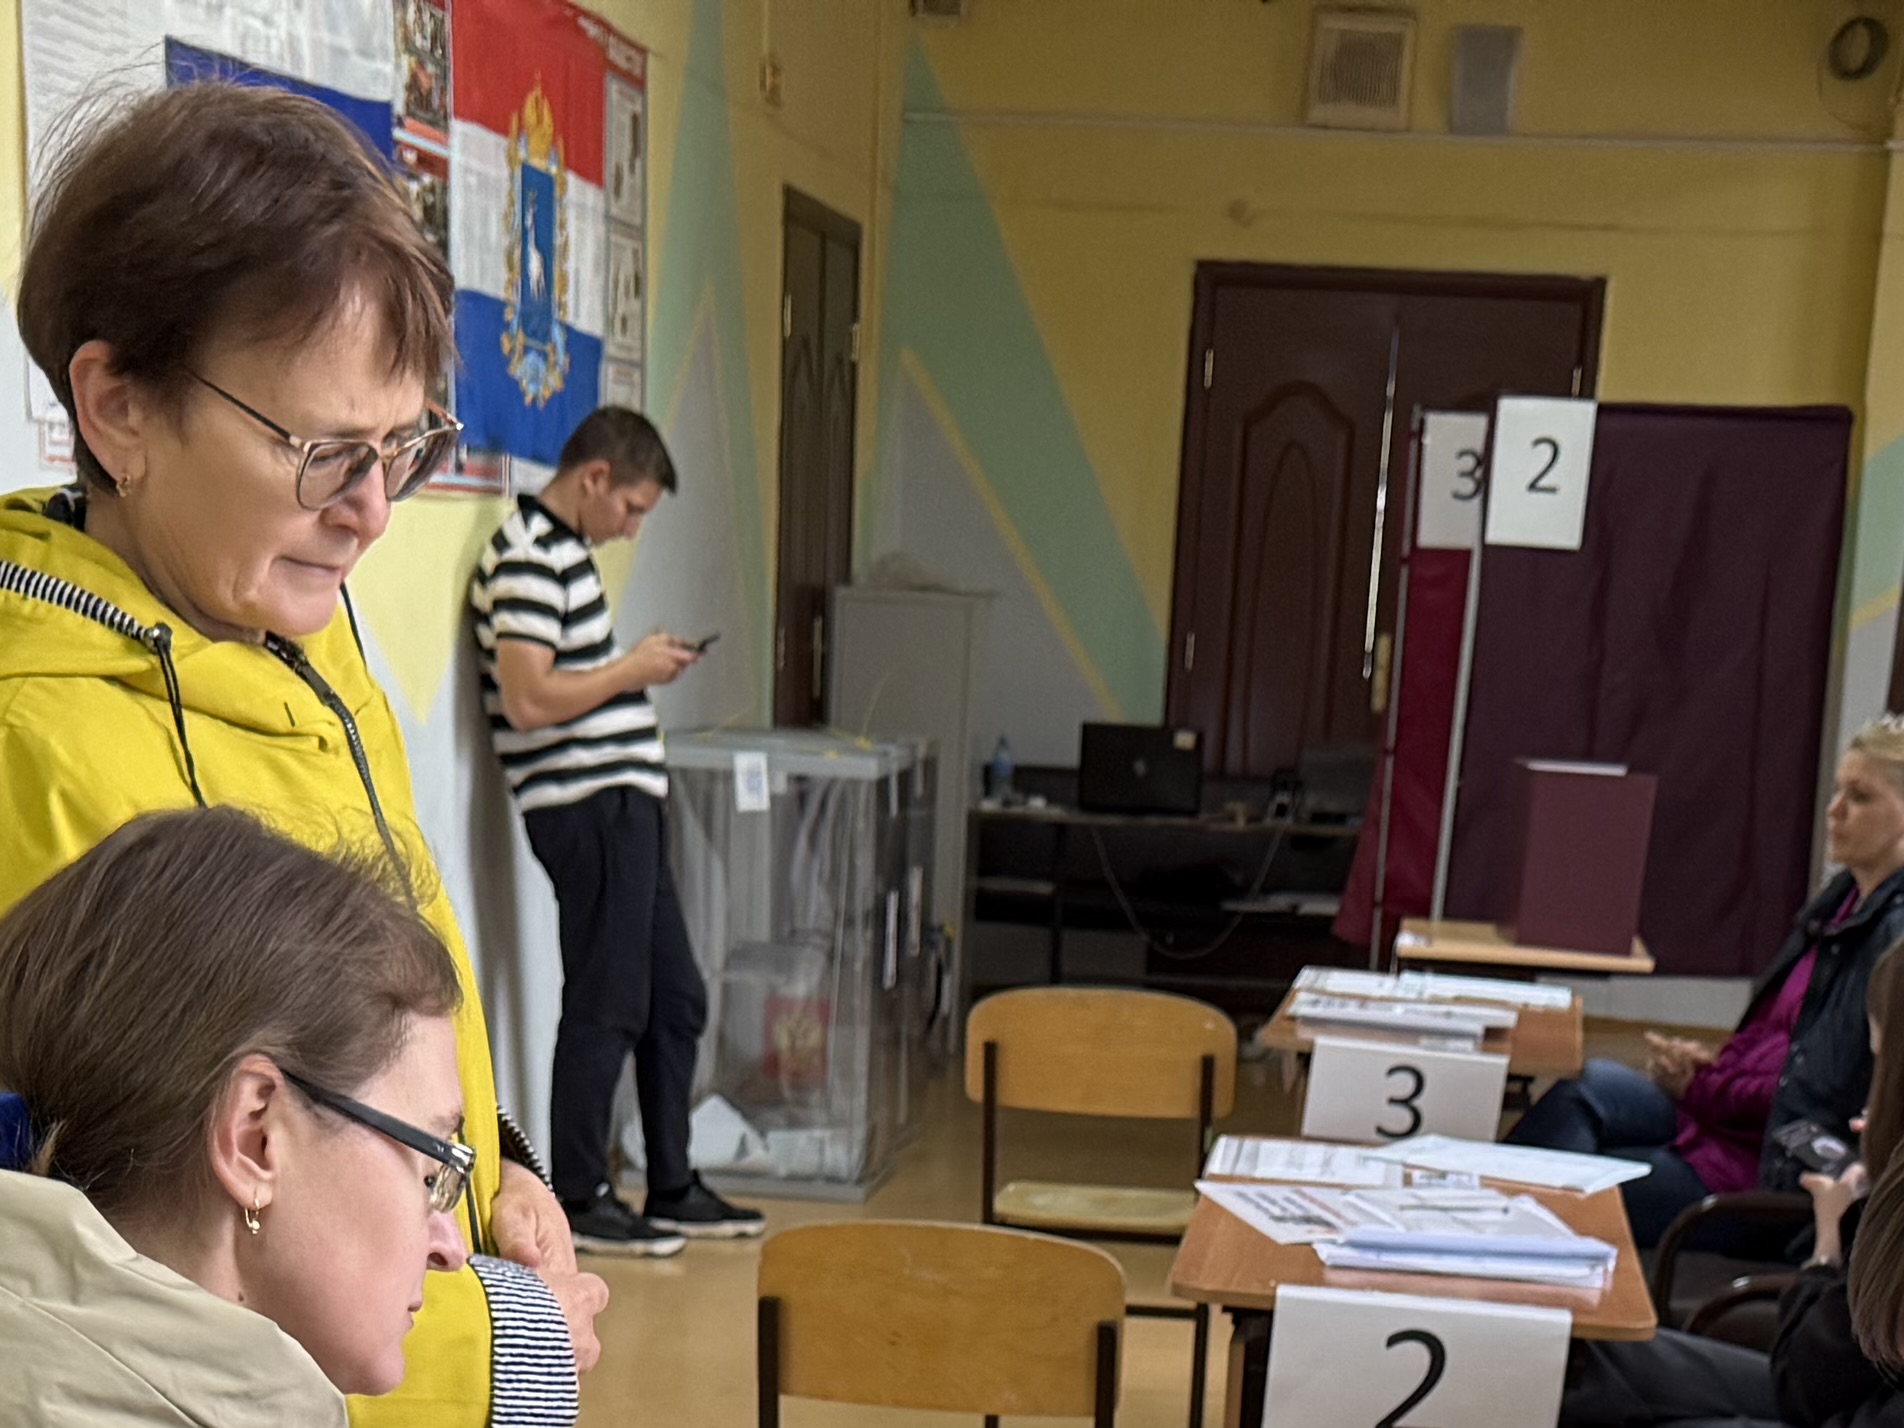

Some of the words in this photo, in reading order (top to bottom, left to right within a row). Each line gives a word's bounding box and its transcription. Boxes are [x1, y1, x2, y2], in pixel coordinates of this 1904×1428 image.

[1451, 449, 1483, 501] 3
[1526, 437, 1560, 494] 2
[1375, 1065, 1425, 1139] 3
